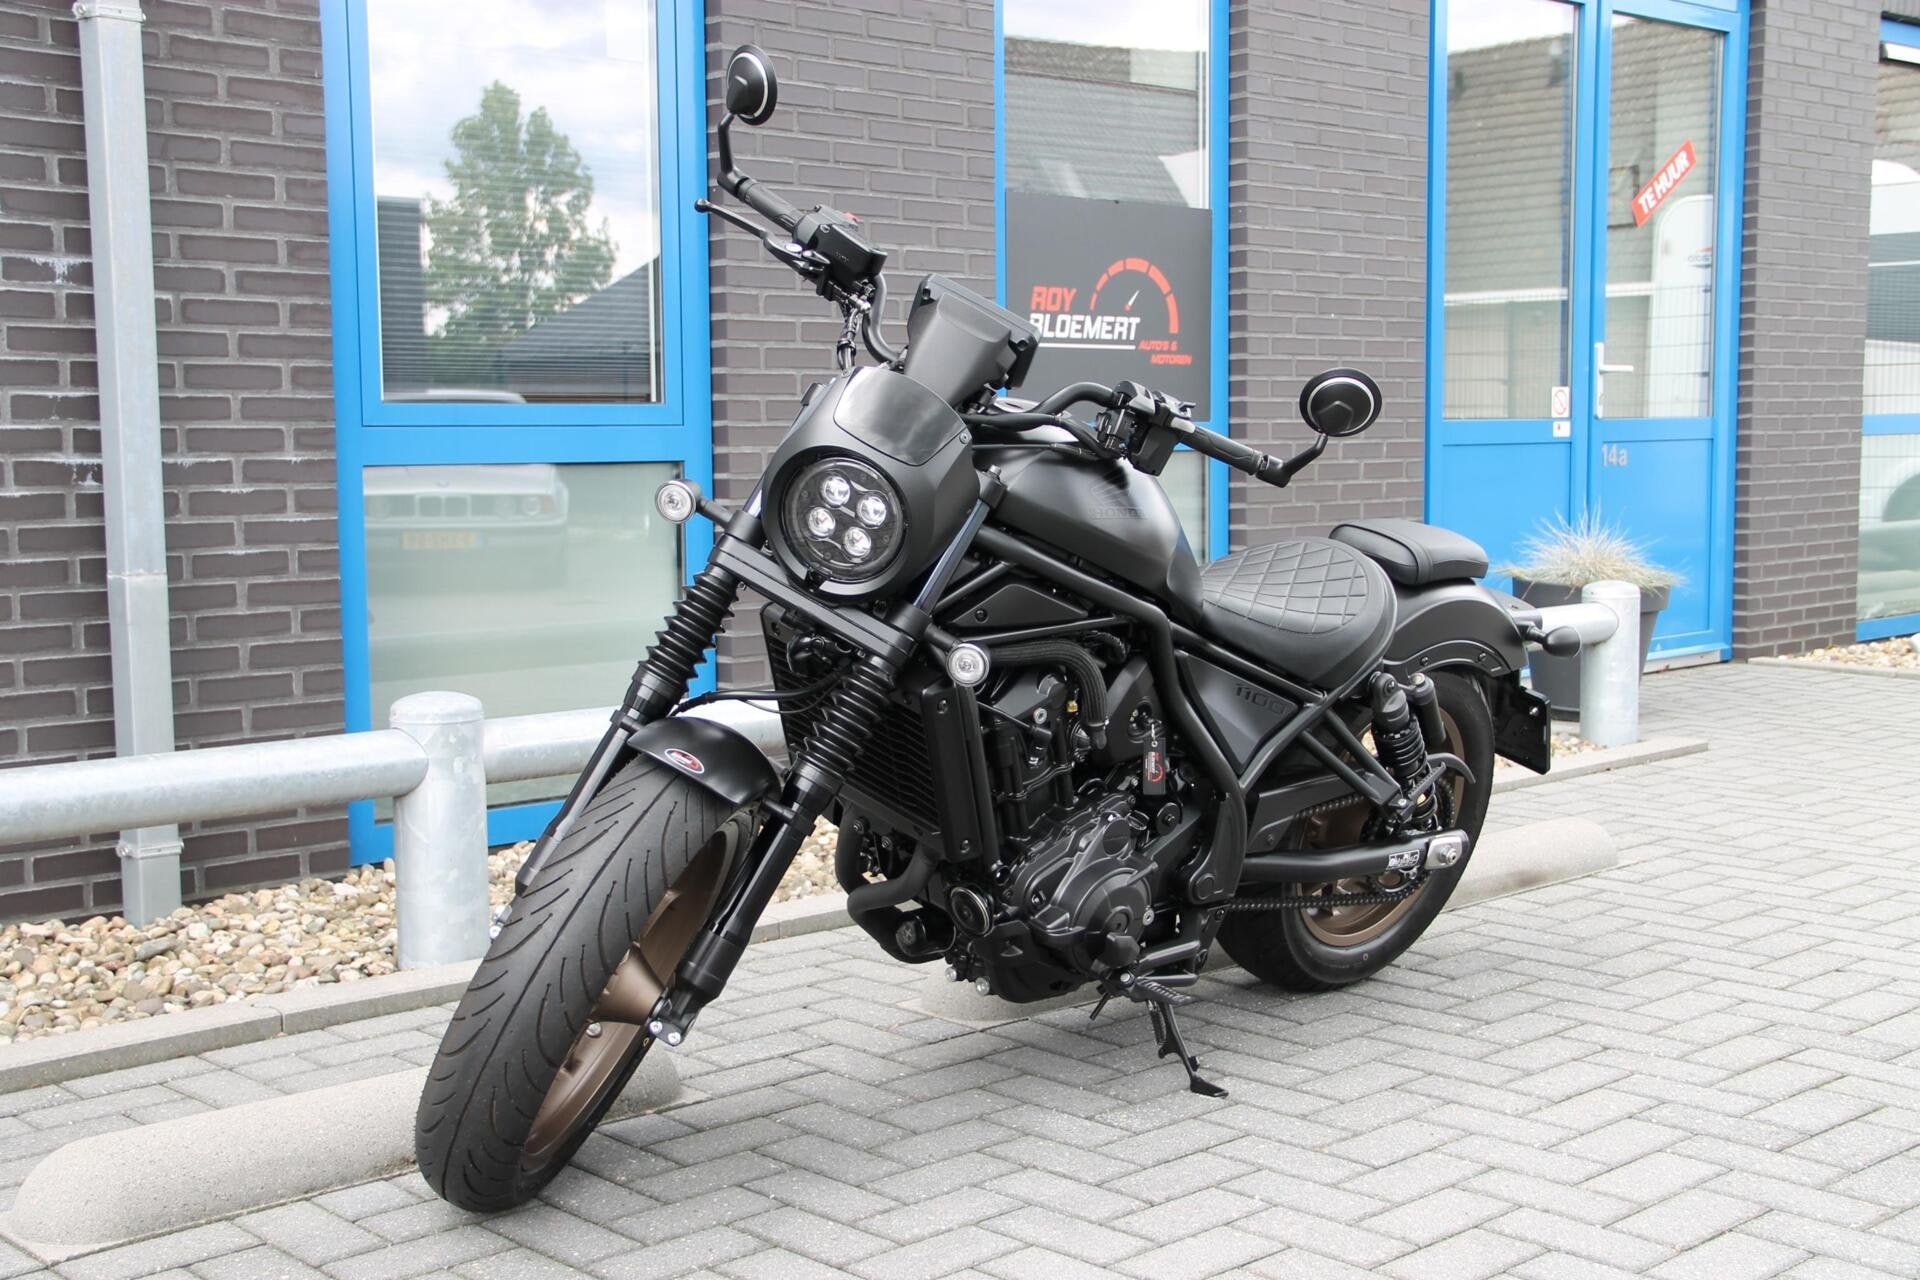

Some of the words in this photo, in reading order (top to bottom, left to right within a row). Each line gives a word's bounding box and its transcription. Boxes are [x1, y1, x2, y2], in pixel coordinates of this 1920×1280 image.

[1638, 186, 1658, 215] TE
[1653, 150, 1690, 200] HUUR
[1031, 286, 1077, 312] ROY
[1029, 313, 1141, 340] BLOEMERT
[1601, 443, 1628, 466] 14a
